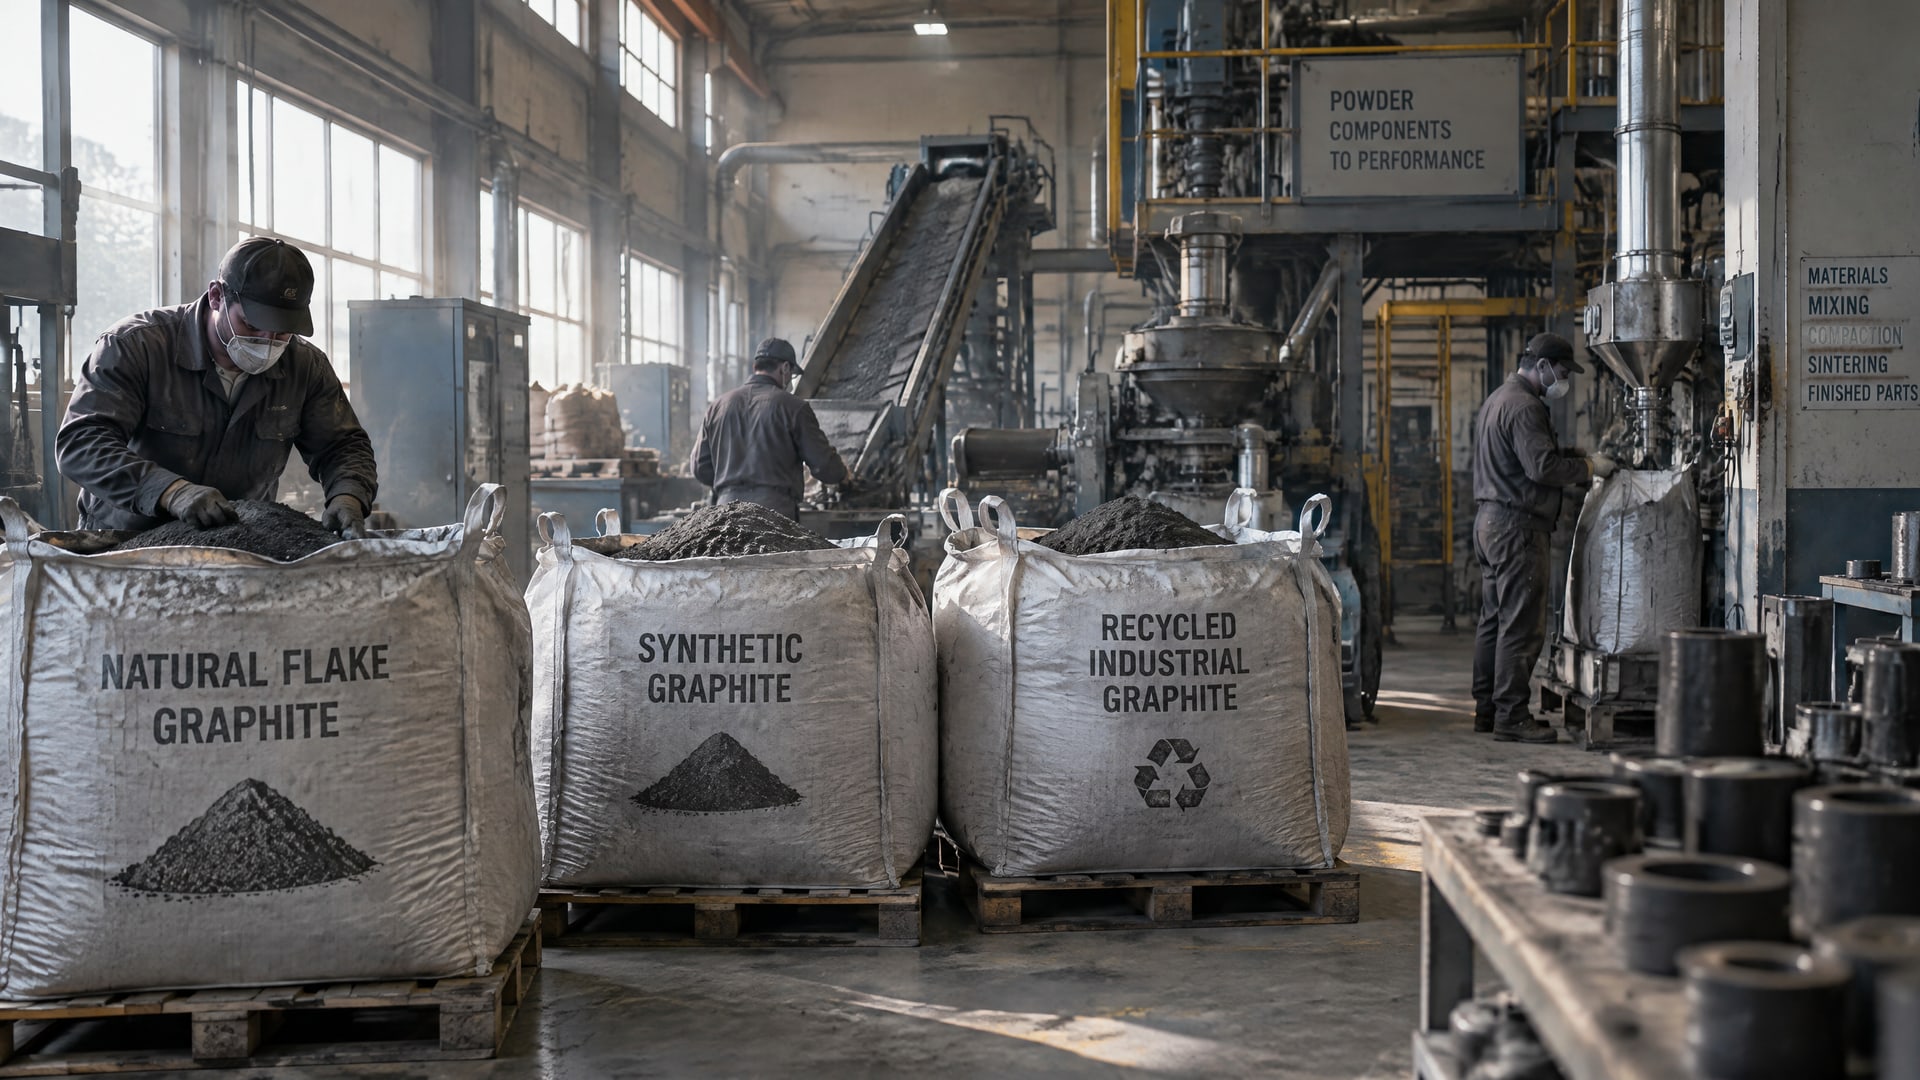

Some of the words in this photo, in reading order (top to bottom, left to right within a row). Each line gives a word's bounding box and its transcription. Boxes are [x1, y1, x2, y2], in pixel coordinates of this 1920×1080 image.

[1330, 90, 1414, 111] POWDER
[1330, 120, 1452, 140] COMPONENTS
[1330, 151, 1351, 170] TO
[1358, 150, 1485, 170] PERFORMANCE
[1808, 267, 1888, 284] MATERIALS
[1808, 295, 1869, 315] MIXING
[1808, 326, 1902, 345] COMPACTION
[1808, 355, 1888, 374] SINTERING
[1808, 384, 1871, 402] FINISHED
[1876, 384, 1918, 401] PARTS
[1102, 612, 1237, 641] RECYCLED
[638, 633, 803, 663] SYNTHETIC
[101, 651, 268, 690] NATURAL
[283, 644, 390, 686] FLAKE
[1089, 647, 1250, 677] INDUSTRIAL
[648, 673, 791, 703] GRAPHITE
[1103, 683, 1238, 712] GRAPHITE
[153, 701, 339, 745] GRAPHITE
